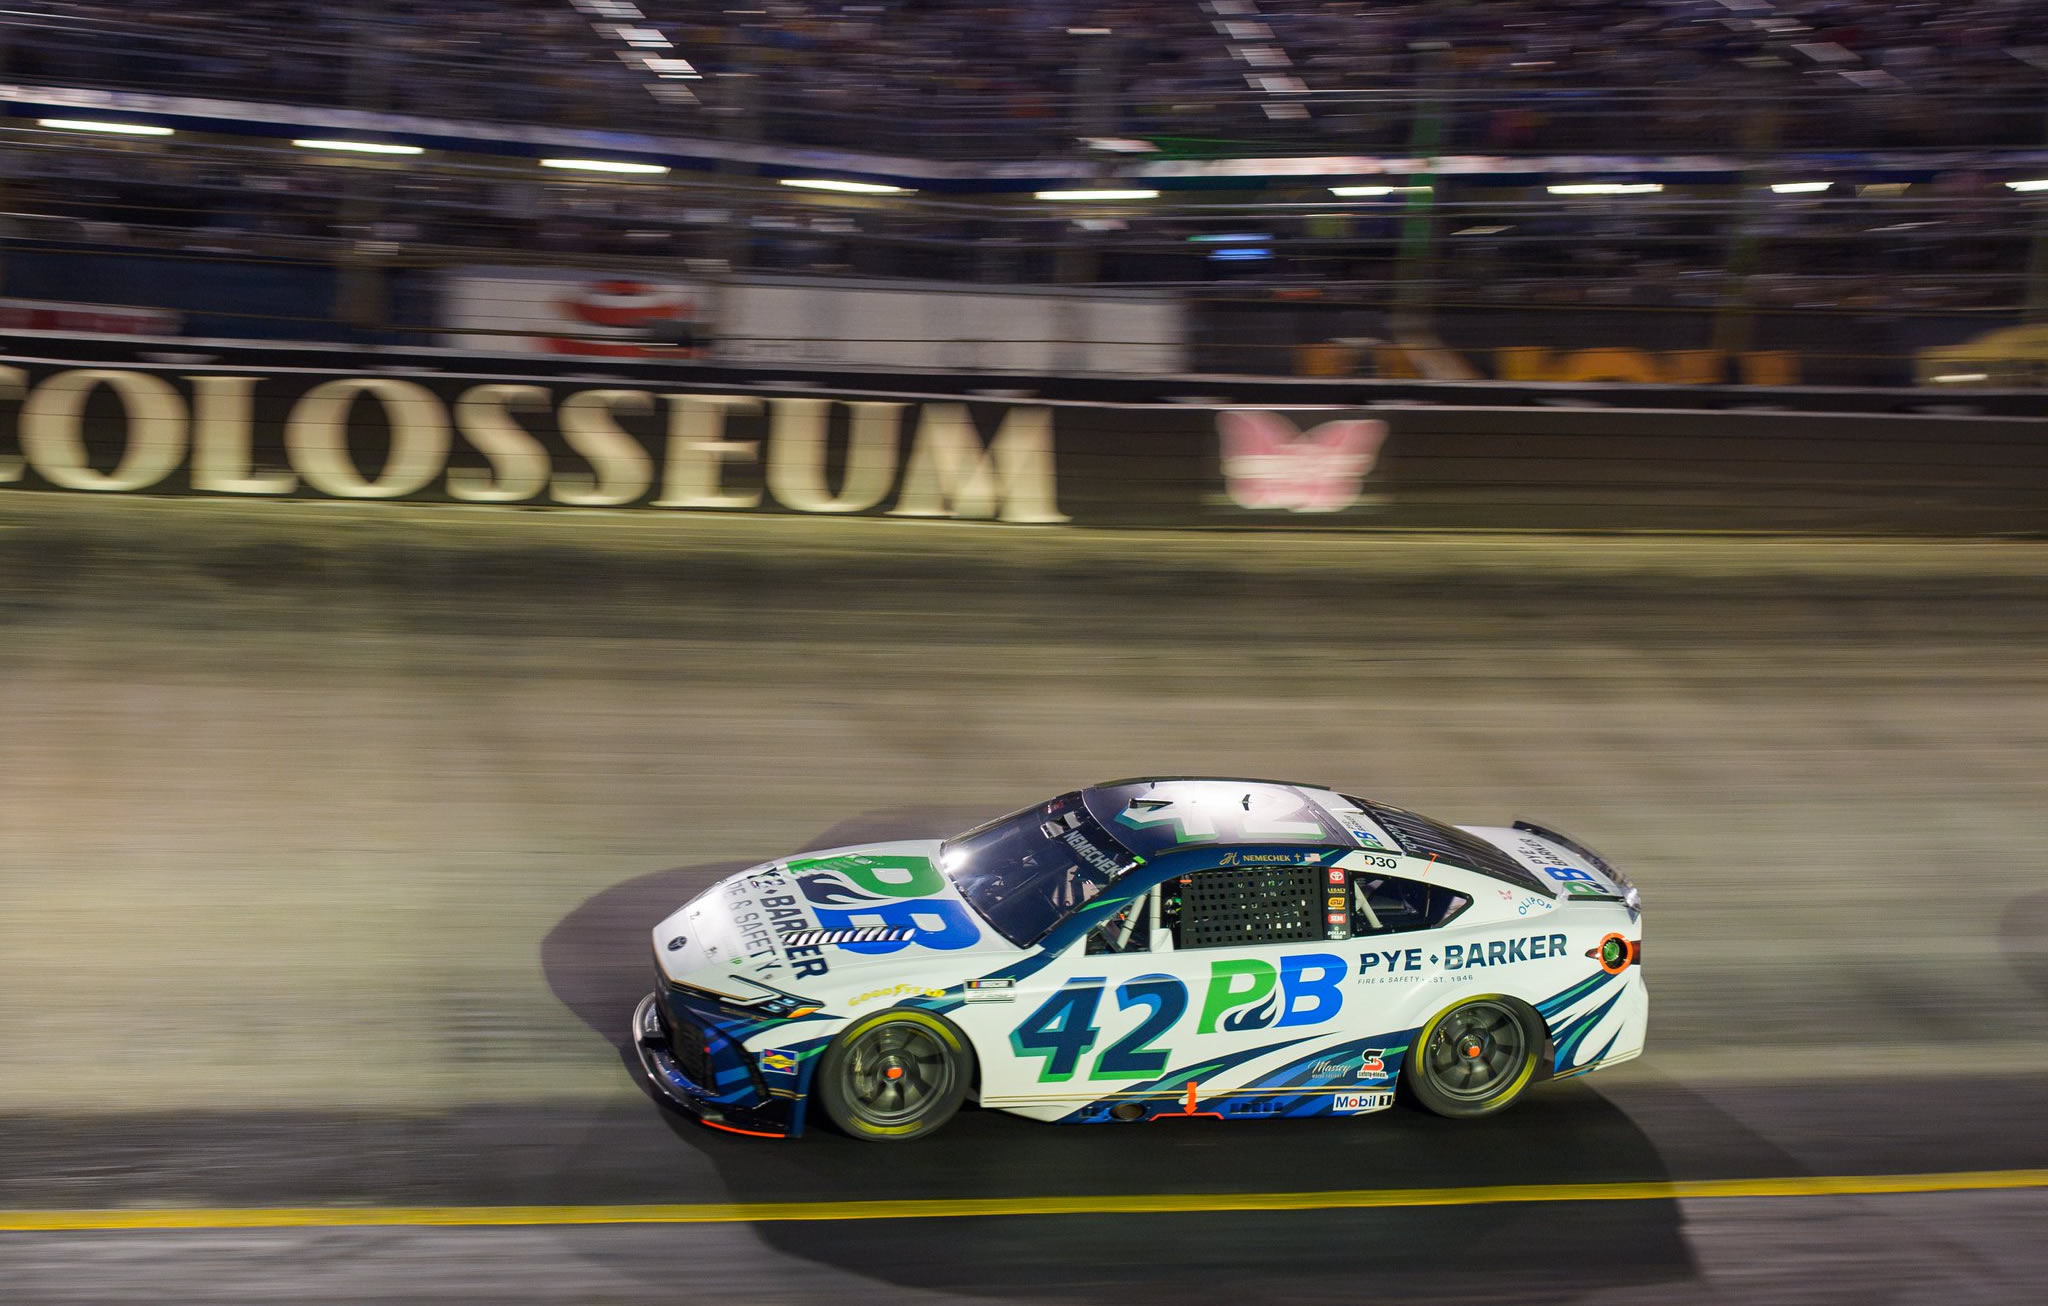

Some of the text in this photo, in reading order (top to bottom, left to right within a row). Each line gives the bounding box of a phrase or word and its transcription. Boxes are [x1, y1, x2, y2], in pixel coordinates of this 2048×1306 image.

[0, 364, 1071, 525] OLOSSEUM
[1063, 830, 1123, 880] NEMECHEK
[1518, 896, 1553, 915] OLIPOP
[759, 894, 829, 980] BARER
[1359, 933, 1568, 975] PYE BARKER
[1196, 953, 1348, 1035] PB
[1357, 977, 1376, 985] FIRE
[1388, 975, 1420, 983] SAFETY
[1451, 974, 1474, 983] 1946
[1008, 972, 1189, 1083] 42
[1336, 1095, 1376, 1108] Mobil
